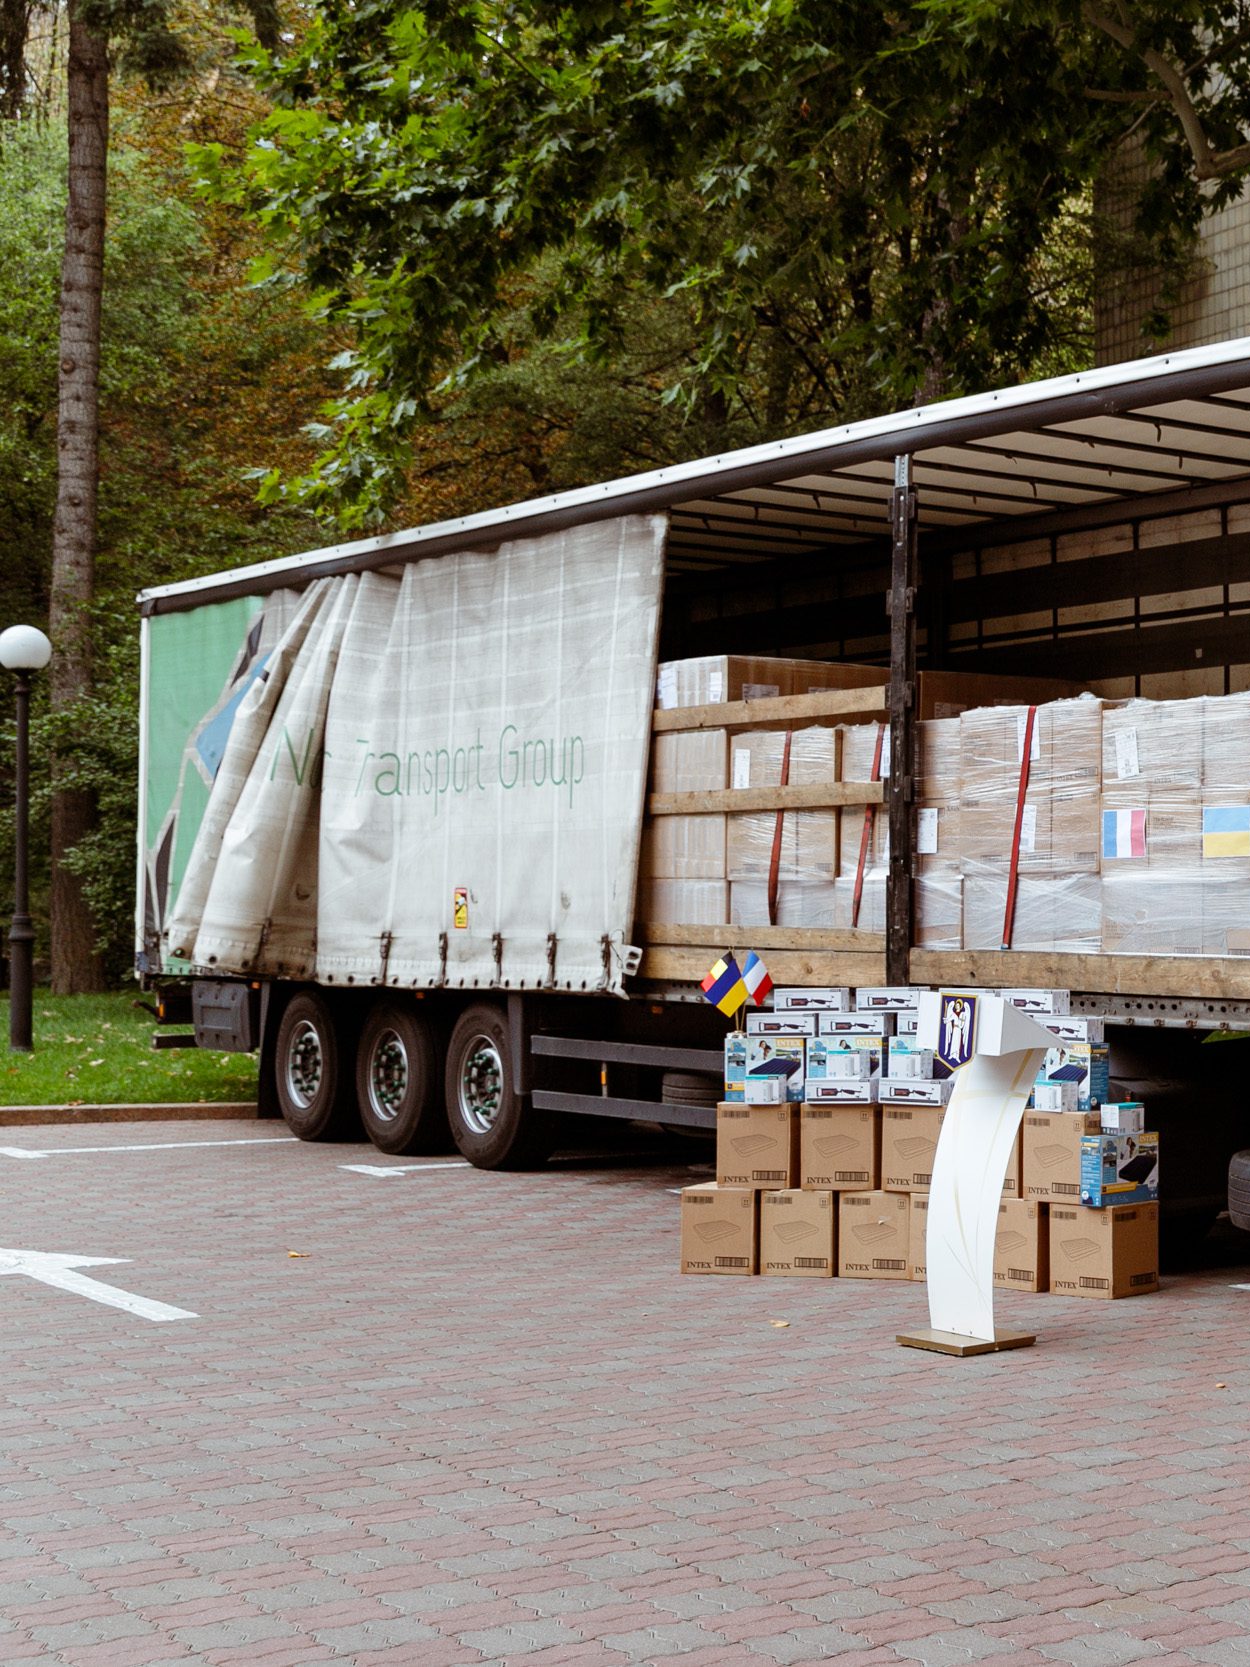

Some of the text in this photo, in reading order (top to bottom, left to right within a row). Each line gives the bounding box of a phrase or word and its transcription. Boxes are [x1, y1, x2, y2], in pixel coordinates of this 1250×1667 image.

[499, 724, 584, 809] Group
[887, 1177, 911, 1186] INTEX
[1028, 1187, 1050, 1196] INTEX
[687, 1261, 712, 1269] INTEX
[766, 1262, 792, 1270] INTEX
[845, 1263, 870, 1271] INTEX
[1055, 1281, 1078, 1290] INTEX
